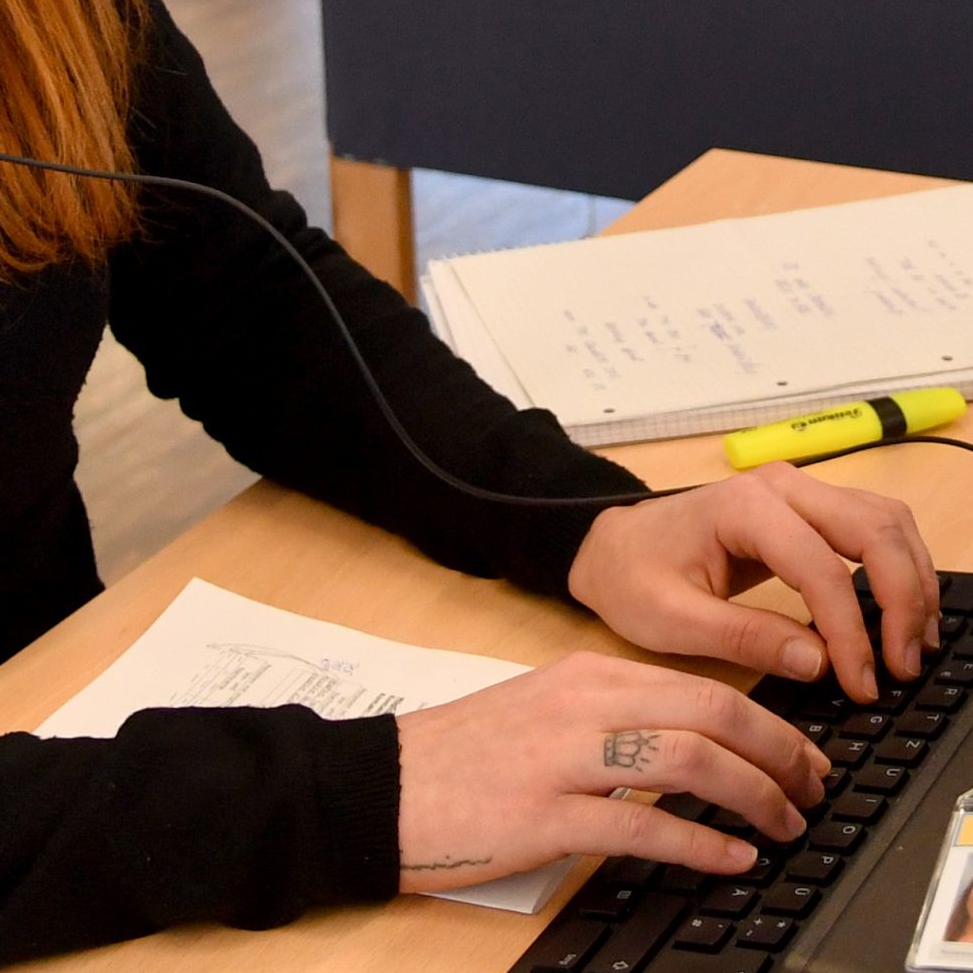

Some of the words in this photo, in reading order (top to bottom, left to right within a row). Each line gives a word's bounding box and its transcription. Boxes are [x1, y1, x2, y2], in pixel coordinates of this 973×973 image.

[944, 688, 958, 696] R
[849, 742, 864, 751] H
[905, 740, 920, 748] Z
[886, 768, 901, 776] U
[842, 826, 856, 834] O
[822, 856, 834, 864] P
